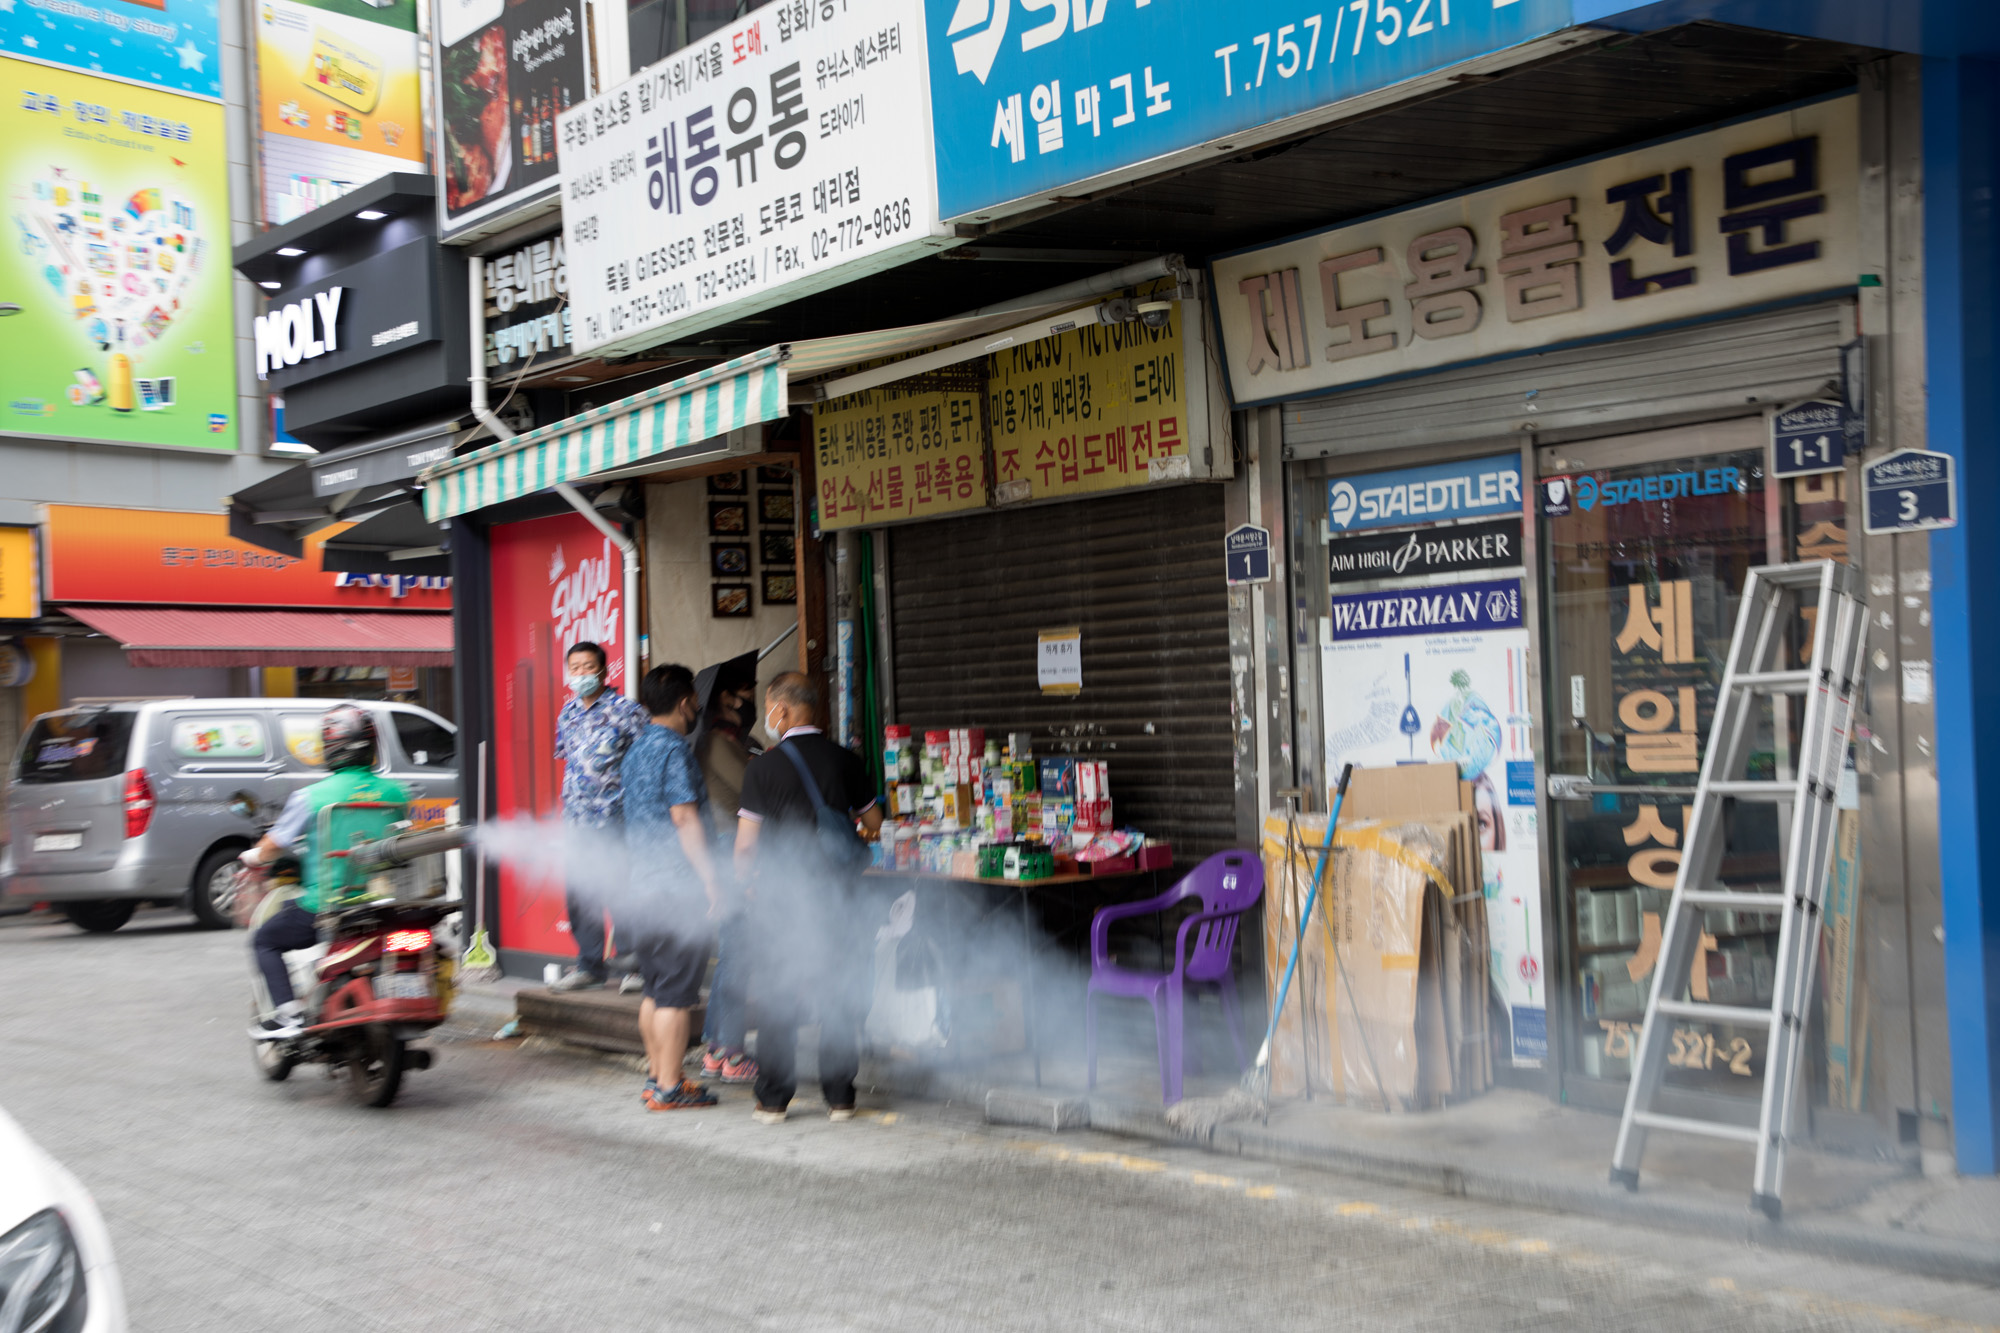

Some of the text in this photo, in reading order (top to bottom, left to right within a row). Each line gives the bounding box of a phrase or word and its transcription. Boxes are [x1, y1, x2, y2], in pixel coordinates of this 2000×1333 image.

[645, 60, 809, 215] 해동유통
[820, 93, 865, 139] 드라이기
[991, 79, 1064, 163] 세일
[636, 237, 697, 281] GIESSER
[760, 192, 804, 235] 도루코
[813, 166, 860, 214] 대리점
[811, 197, 911, 261] 02-772-9636
[254, 286, 342, 376] MOLY
[1790, 435, 1831, 466] 1-1
[1359, 470, 1521, 520] STAEDTLER
[1601, 466, 1740, 507] STAEDTLER
[1898, 490, 1919, 521] 3
[1244, 553, 1251, 576] 1
[1331, 533, 1511, 572] AIM HIGH PARKER
[1332, 591, 1482, 632] WATERMAN
